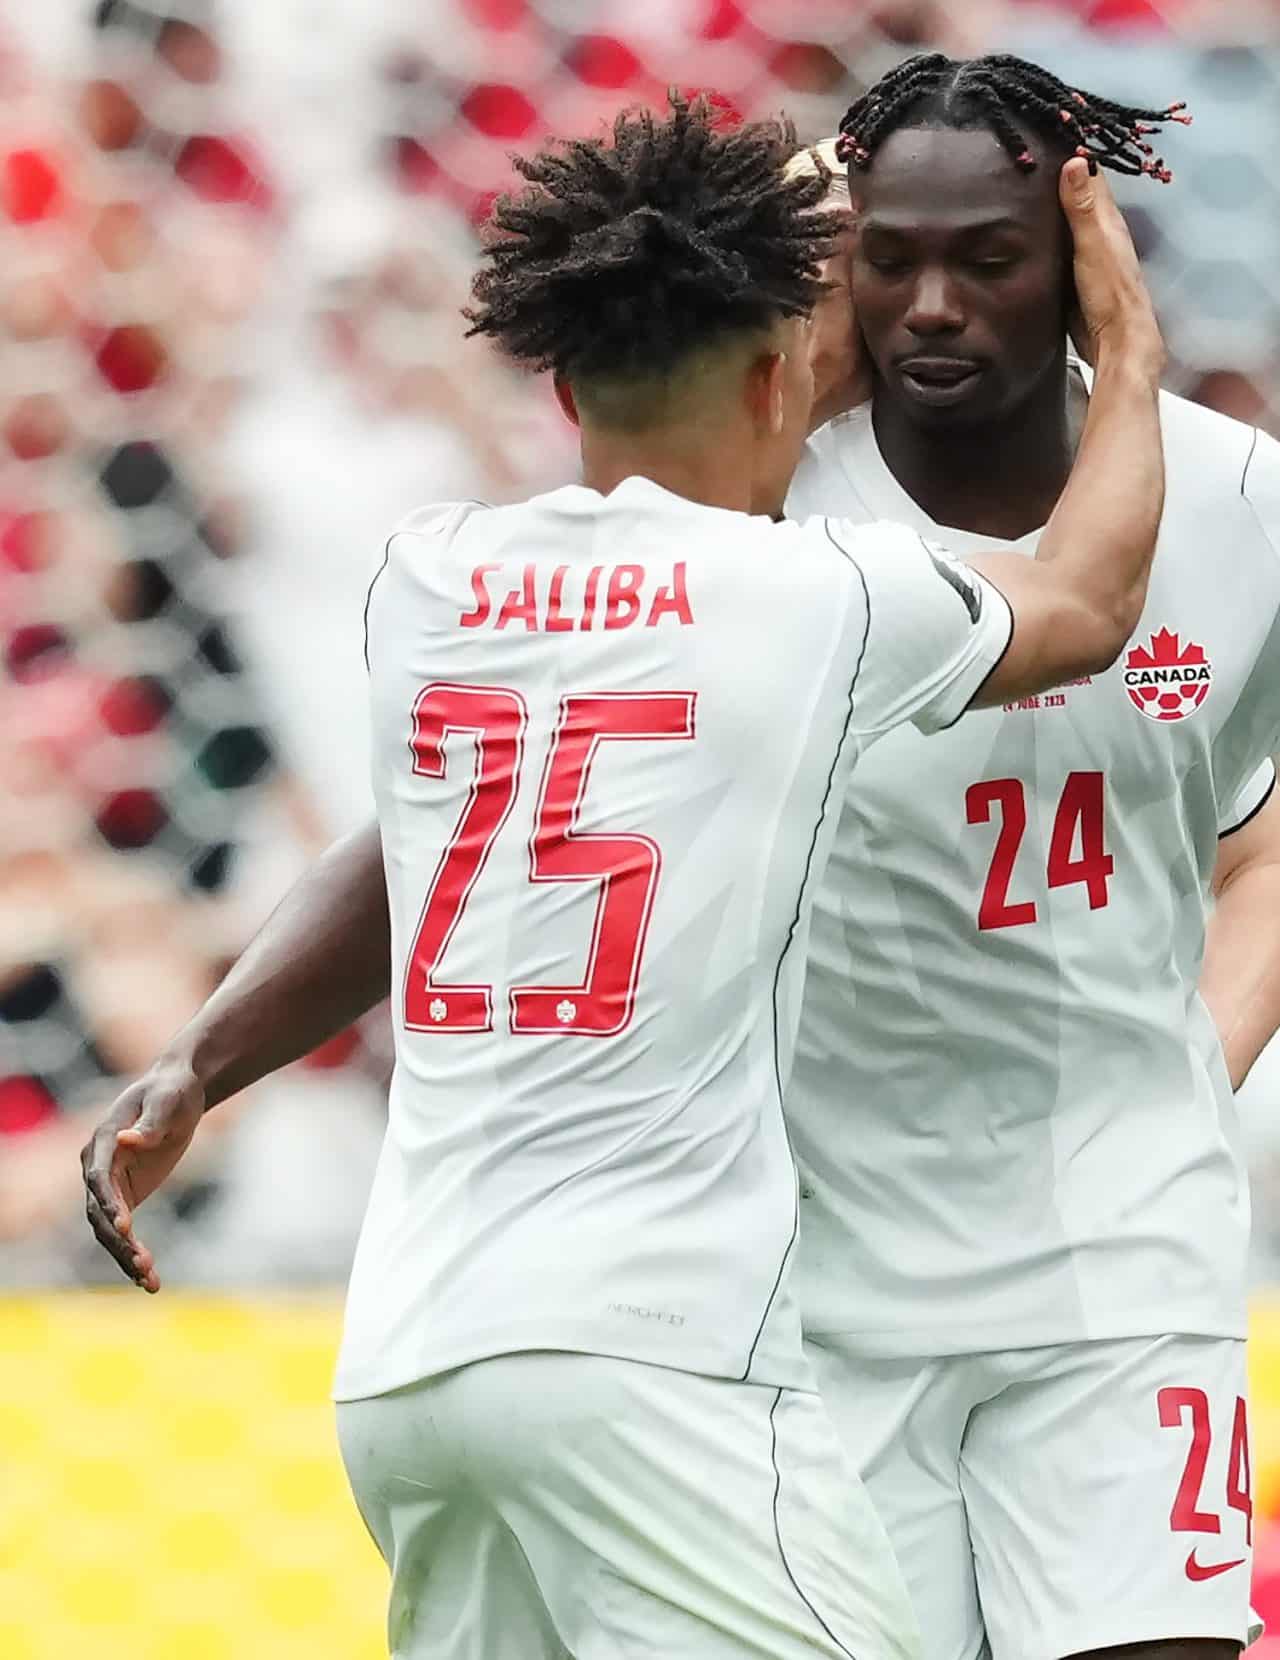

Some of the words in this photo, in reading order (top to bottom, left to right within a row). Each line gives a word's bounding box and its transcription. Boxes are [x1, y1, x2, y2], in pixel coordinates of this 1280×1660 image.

[459, 561, 694, 633] SALIBA
[1124, 667, 1211, 686] CANADA
[403, 681, 699, 1039] 25
[965, 771, 1114, 930] 24
[1157, 1386, 1253, 1547] 24
